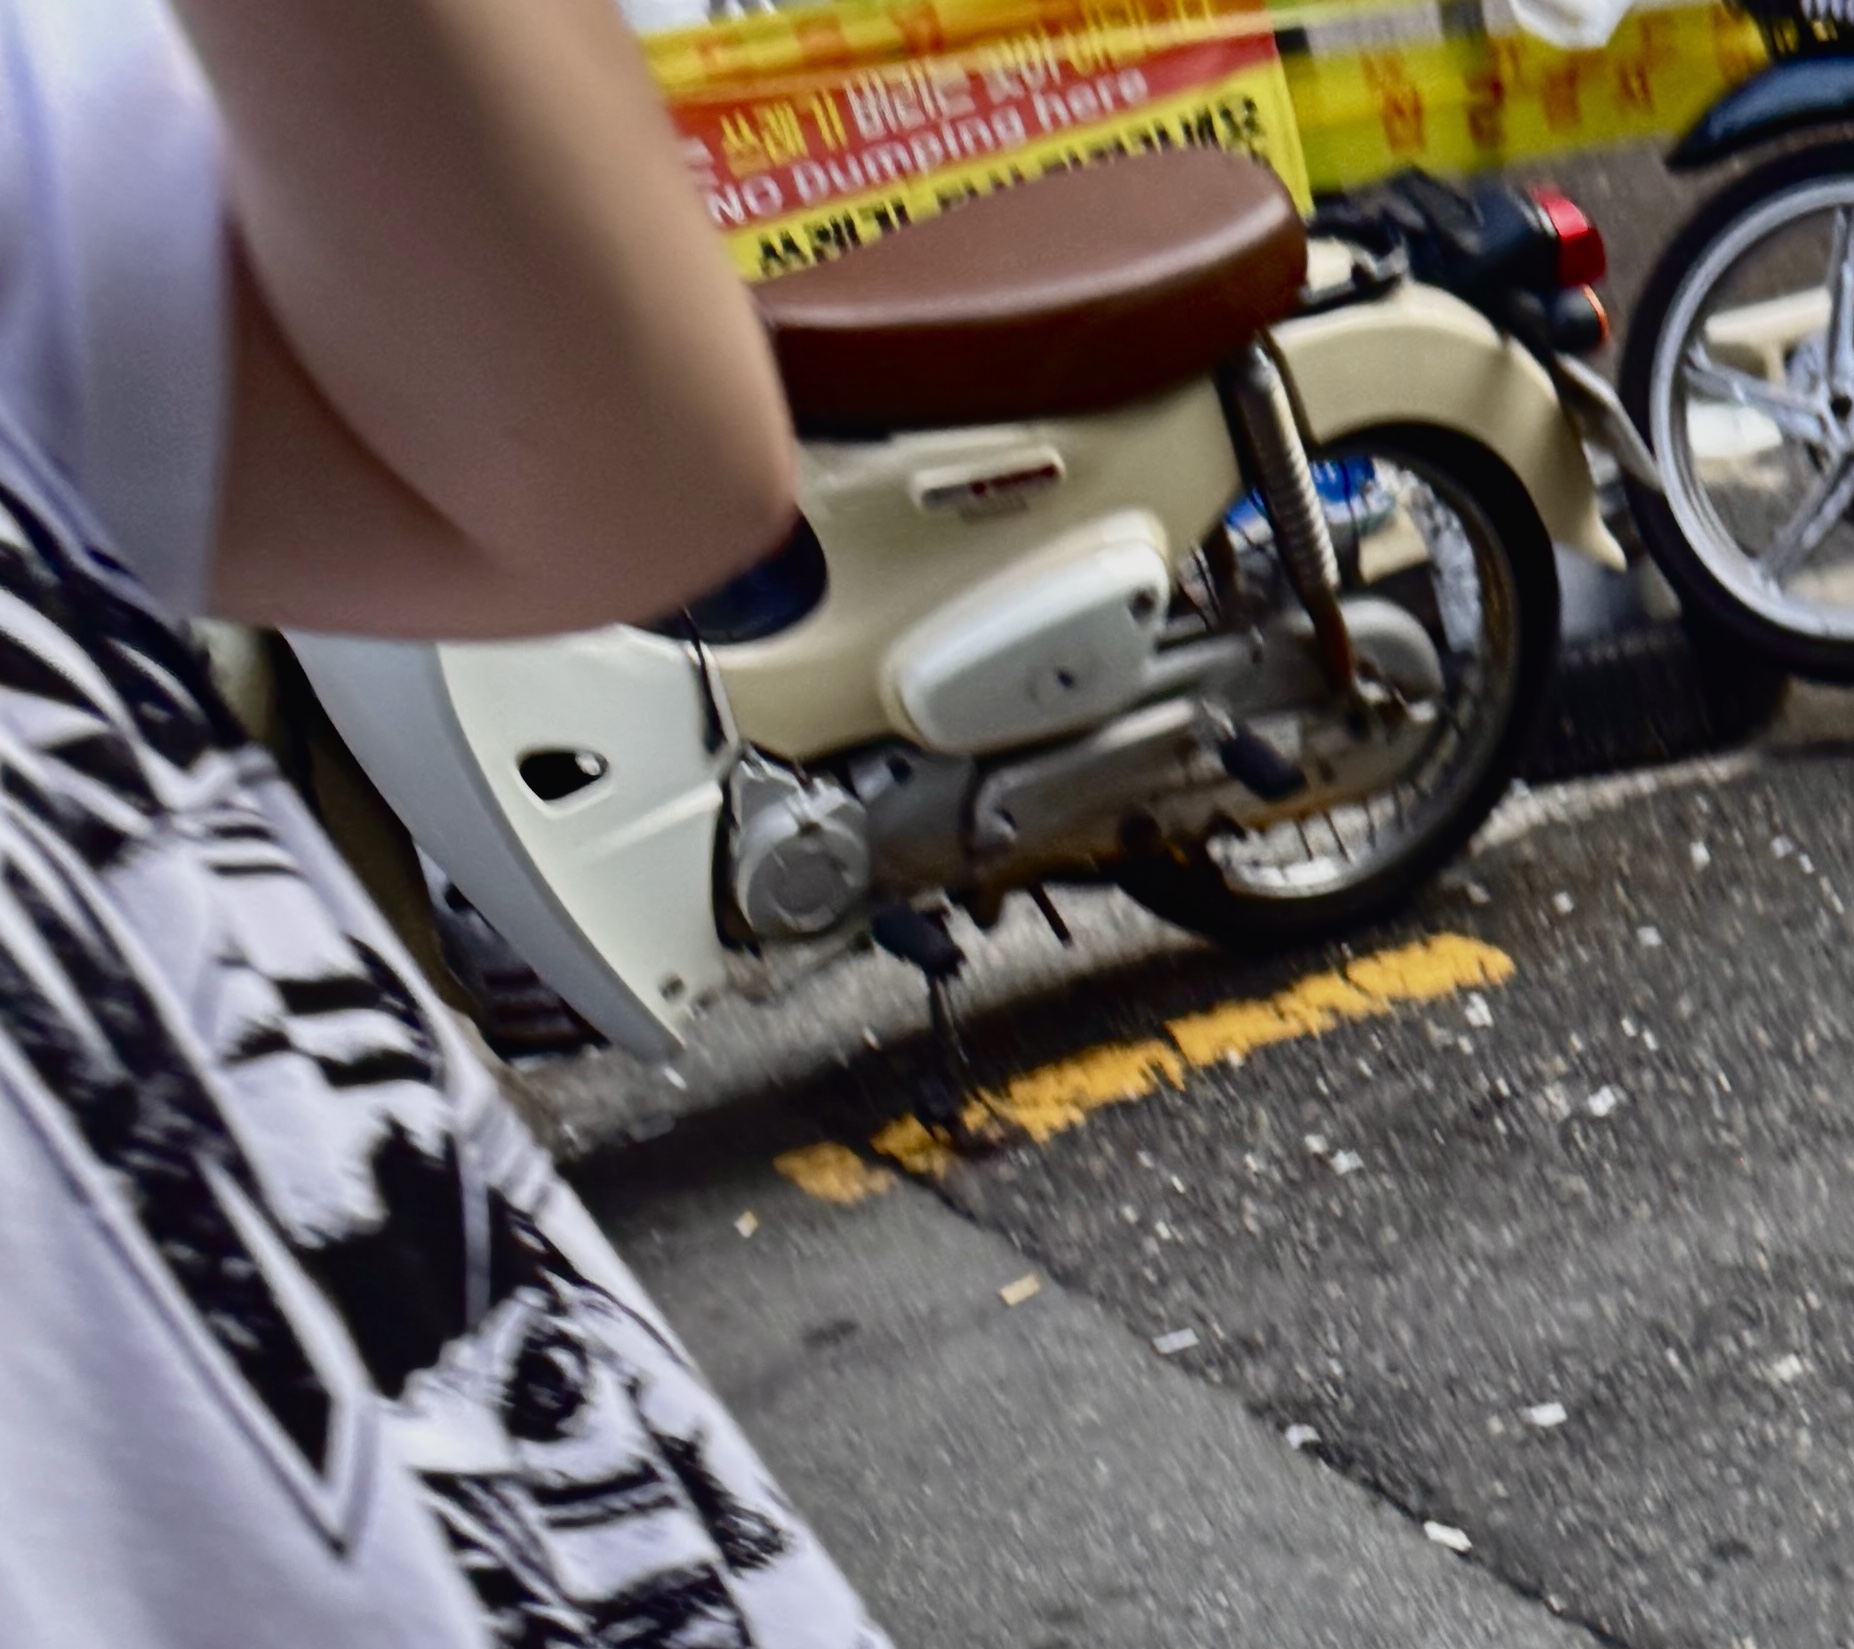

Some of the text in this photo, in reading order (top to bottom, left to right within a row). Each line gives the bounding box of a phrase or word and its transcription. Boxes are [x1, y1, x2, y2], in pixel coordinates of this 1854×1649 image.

[719, 88, 848, 180] 쓰레기
[792, 105, 1027, 206] Dumping
[1030, 67, 1148, 132] here
